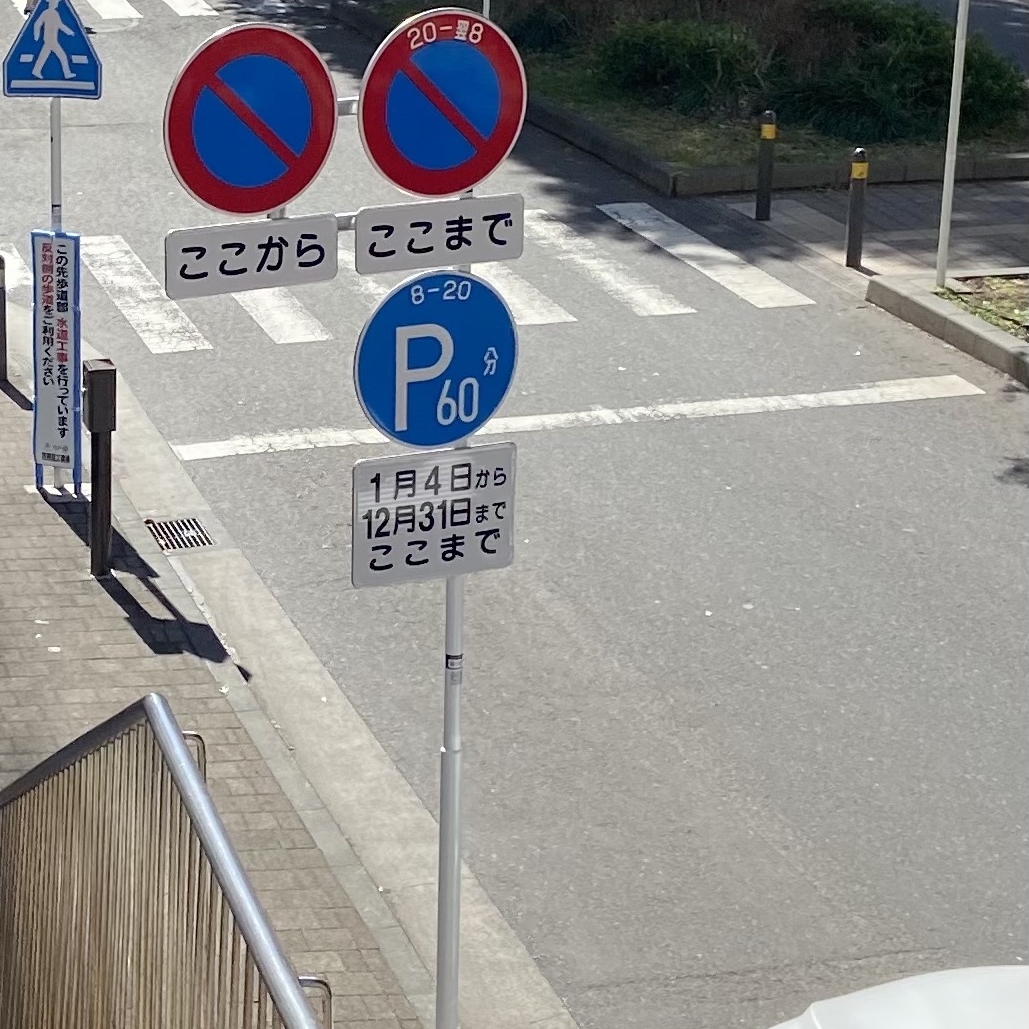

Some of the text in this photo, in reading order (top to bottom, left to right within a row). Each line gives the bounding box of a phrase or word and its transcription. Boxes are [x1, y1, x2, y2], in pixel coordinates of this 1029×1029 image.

[178, 232, 326, 281] ここから
[368, 212, 513, 259] ここまで
[410, 280, 472, 305] 8-20
[395, 323, 454, 432] P
[361, 496, 507, 539] 12月31日まで
[369, 528, 501, 571] ここまで
